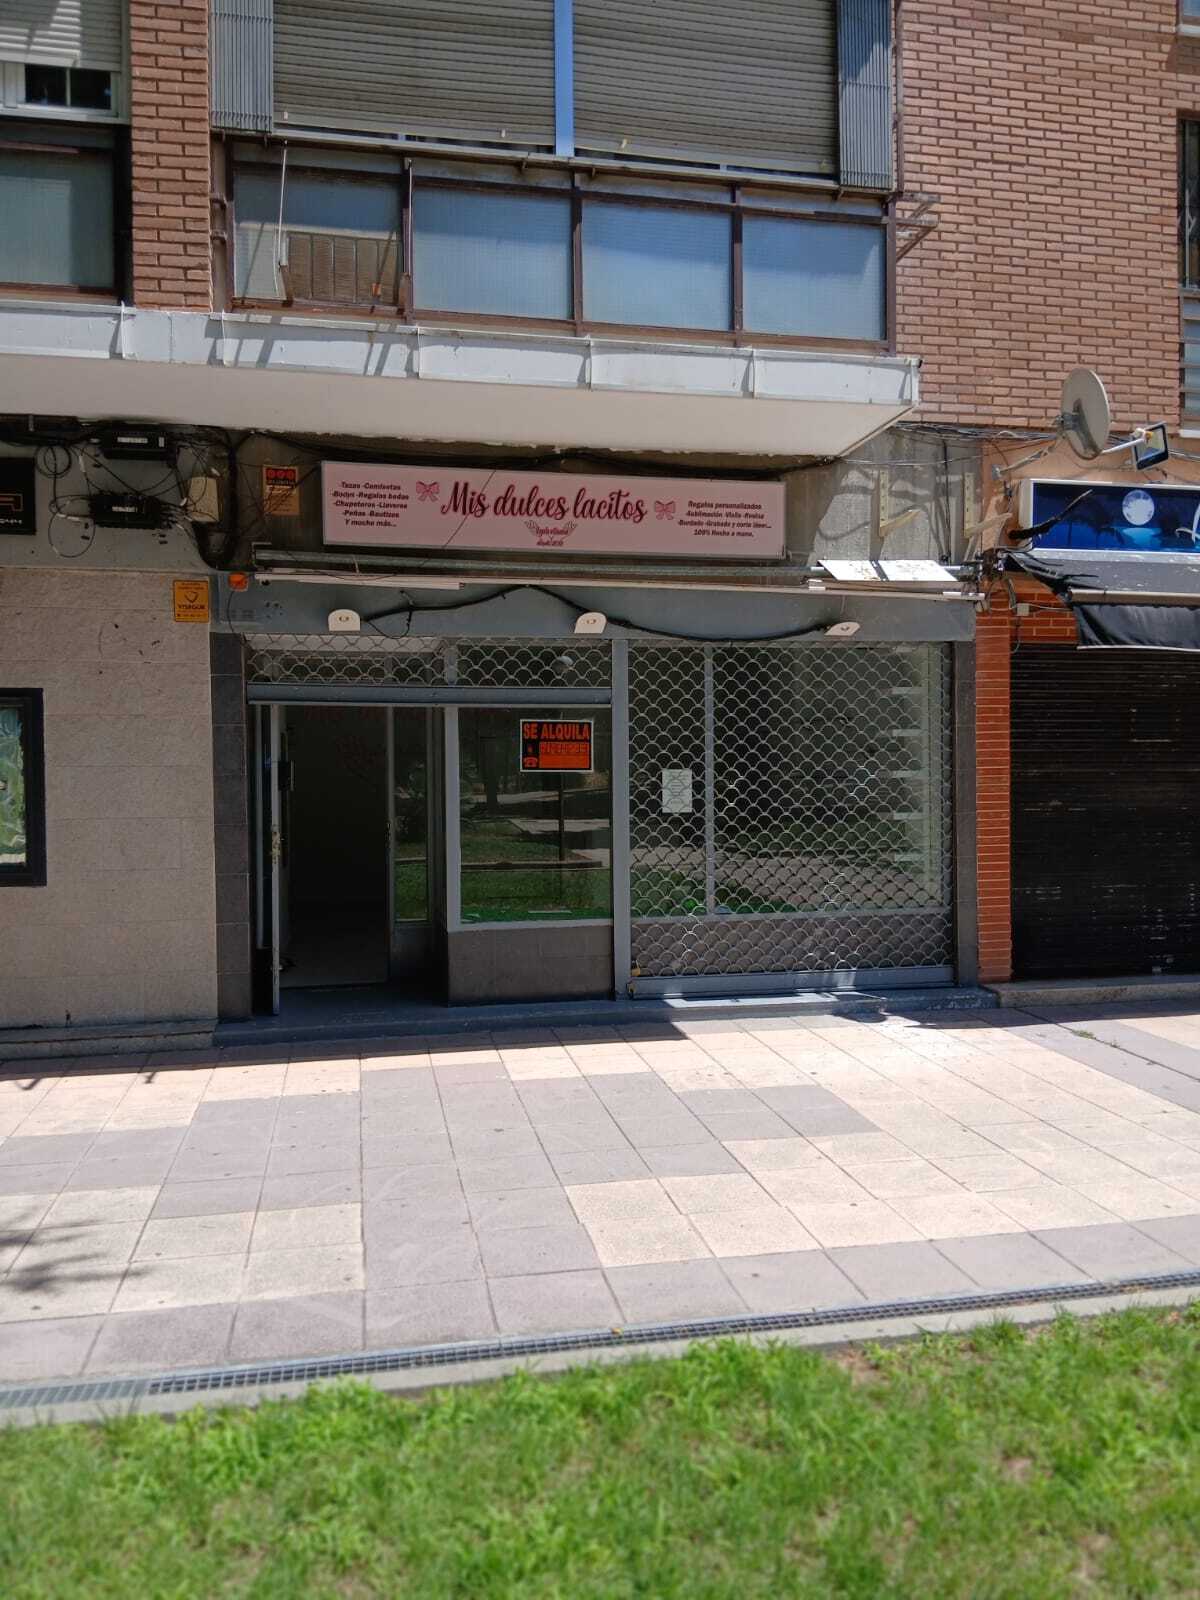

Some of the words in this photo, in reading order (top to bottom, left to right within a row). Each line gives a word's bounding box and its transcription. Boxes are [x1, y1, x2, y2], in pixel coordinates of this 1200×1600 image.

[388, 492, 409, 500] bodas
[440, 480, 490, 518] Mis
[493, 484, 569, 520] dulces
[573, 487, 648, 523] lacitos
[688, 500, 714, 509] Regalos
[715, 502, 762, 510] personalizados
[351, 519, 375, 527] mucho
[694, 528, 710, 537] 100%
[523, 723, 538, 739] SE
[540, 723, 590, 740] ALQUILA
